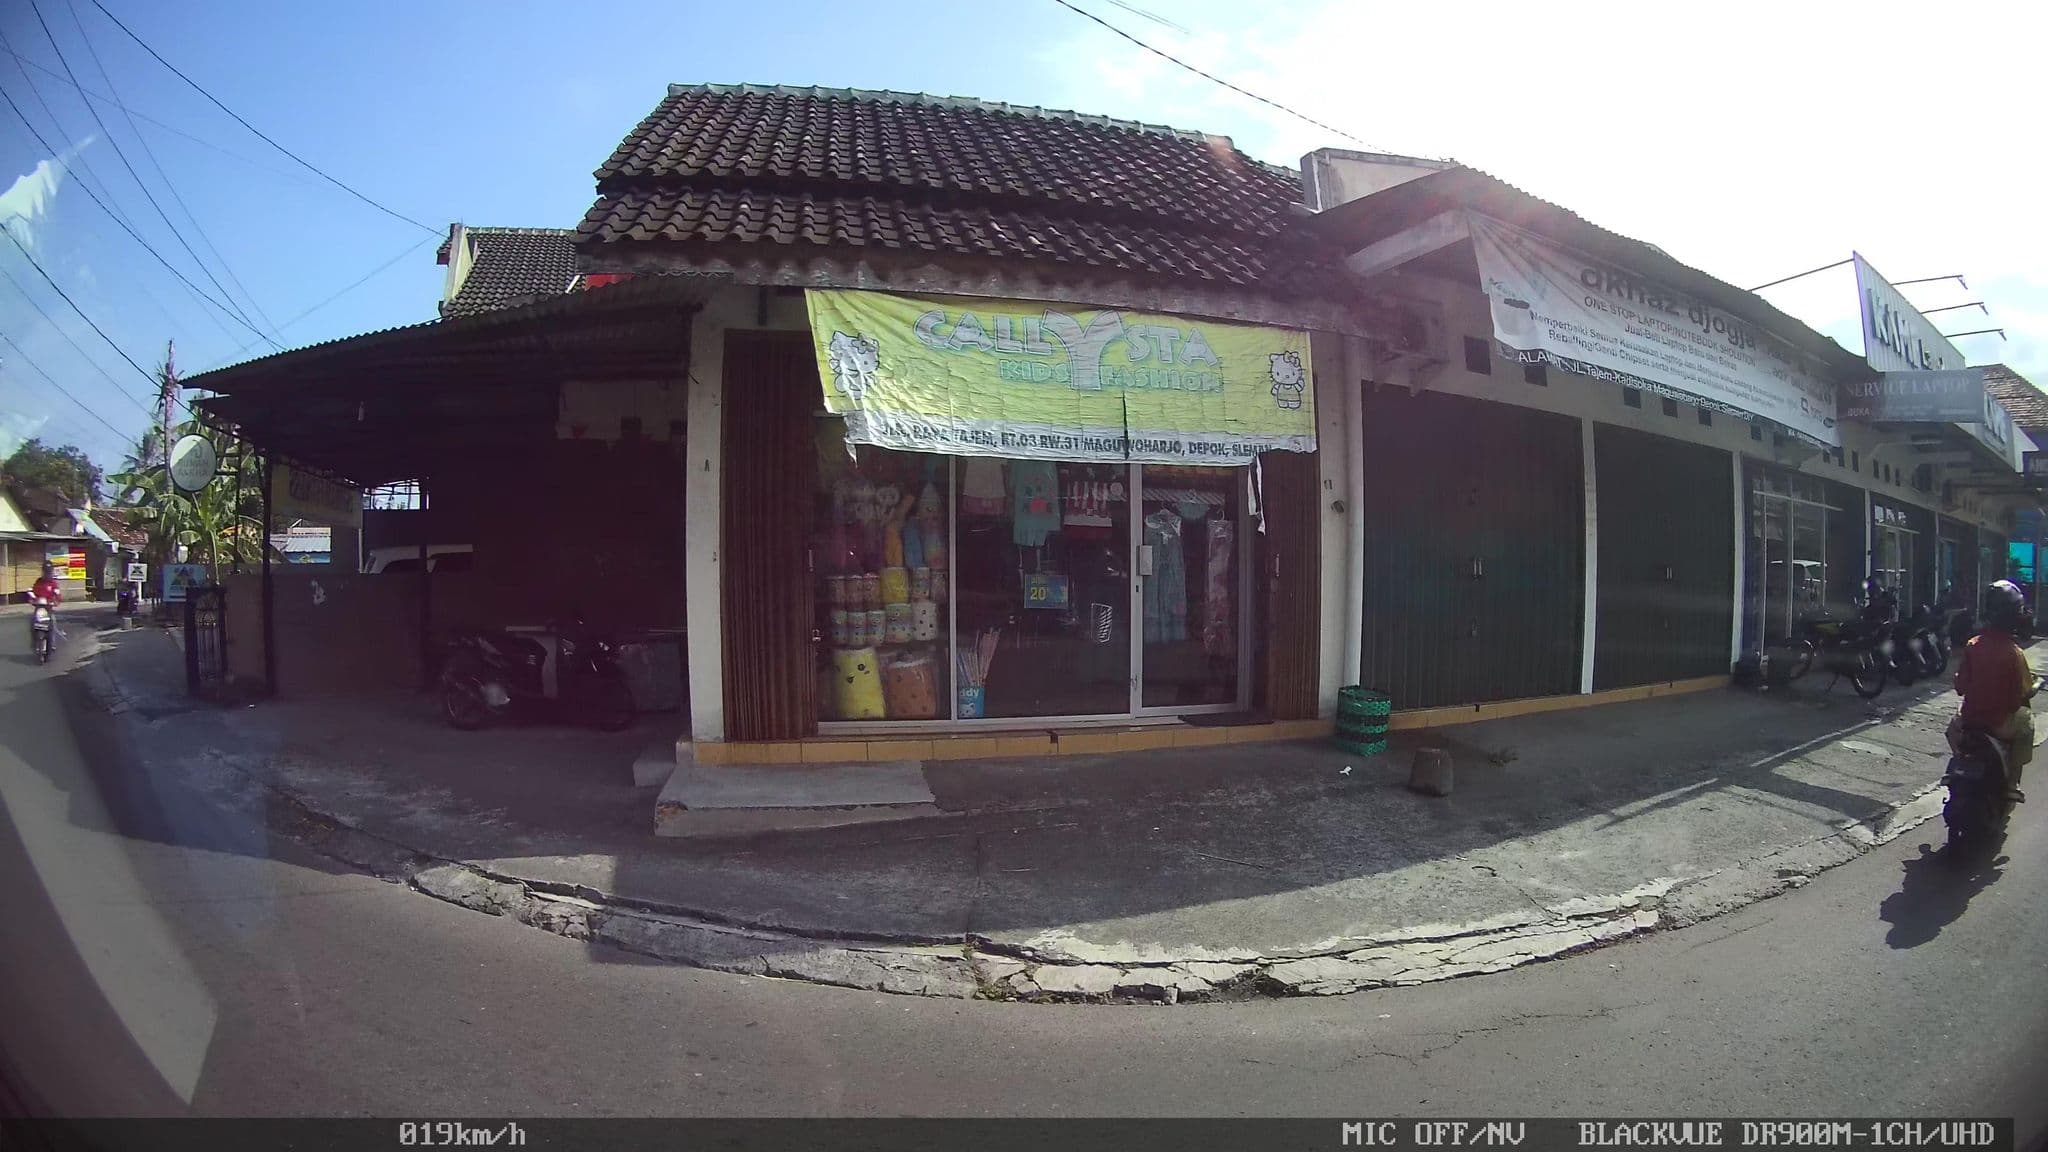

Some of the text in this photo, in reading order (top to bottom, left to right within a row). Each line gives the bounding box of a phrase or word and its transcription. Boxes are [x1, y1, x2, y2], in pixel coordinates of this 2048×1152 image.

[1529, 309, 1588, 336] Memperbaiki
[1584, 295, 1609, 312] ONE
[1610, 304, 1636, 320] STOP
[913, 308, 1219, 390] CALLYSTA
[1000, 359, 1223, 393] KIDS FASHION
